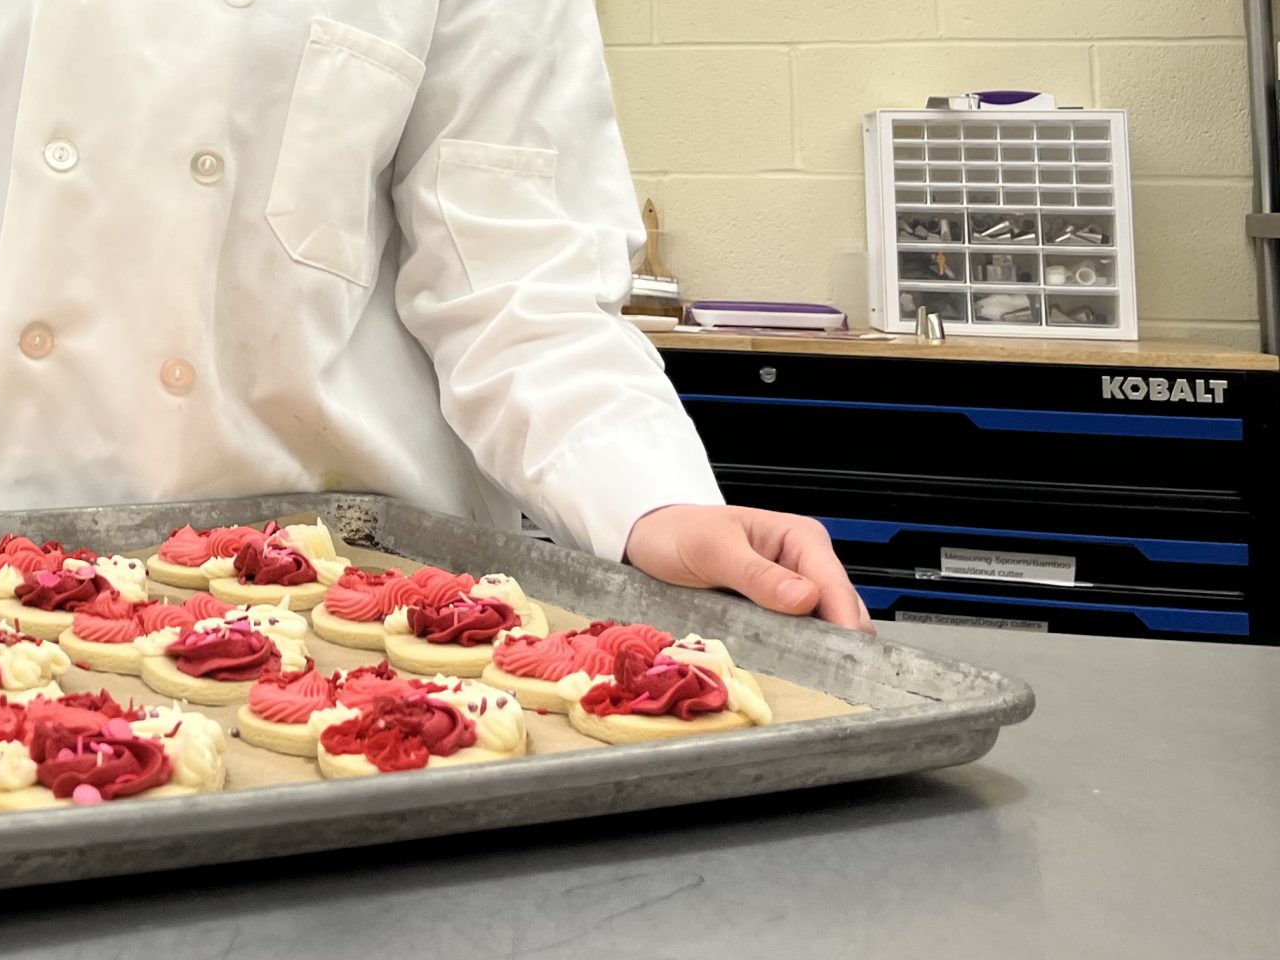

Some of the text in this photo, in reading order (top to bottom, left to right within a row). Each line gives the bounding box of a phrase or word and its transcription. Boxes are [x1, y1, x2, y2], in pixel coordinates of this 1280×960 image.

[1101, 375, 1228, 404] KOBALT
[944, 552, 1071, 569] Measuring Spoons/Bamboo
[945, 565, 1024, 579] mats/donut cutter
[902, 612, 932, 623] Dough
[1010, 620, 1042, 629] cutters
